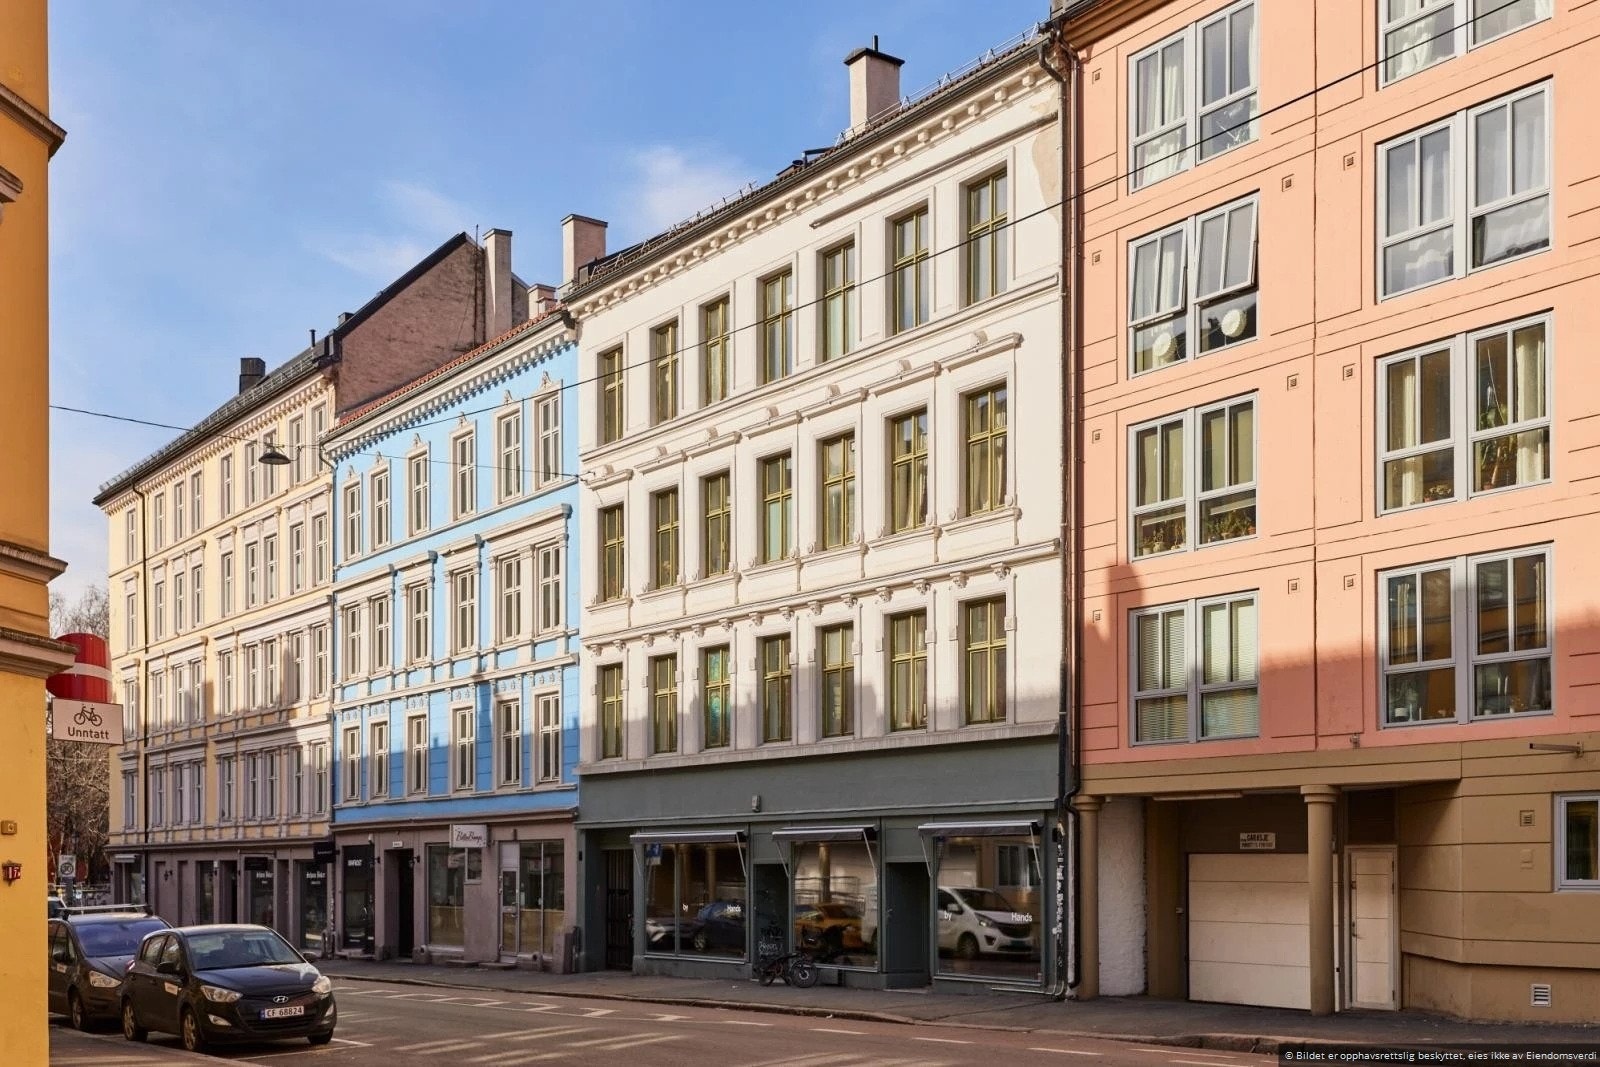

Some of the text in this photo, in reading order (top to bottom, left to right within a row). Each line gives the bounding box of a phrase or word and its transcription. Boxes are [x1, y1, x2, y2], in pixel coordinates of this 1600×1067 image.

[68, 726, 109, 740] Unntatt
[944, 910, 1033, 922] by Hands
[280, 1007, 302, 1016] 68824
